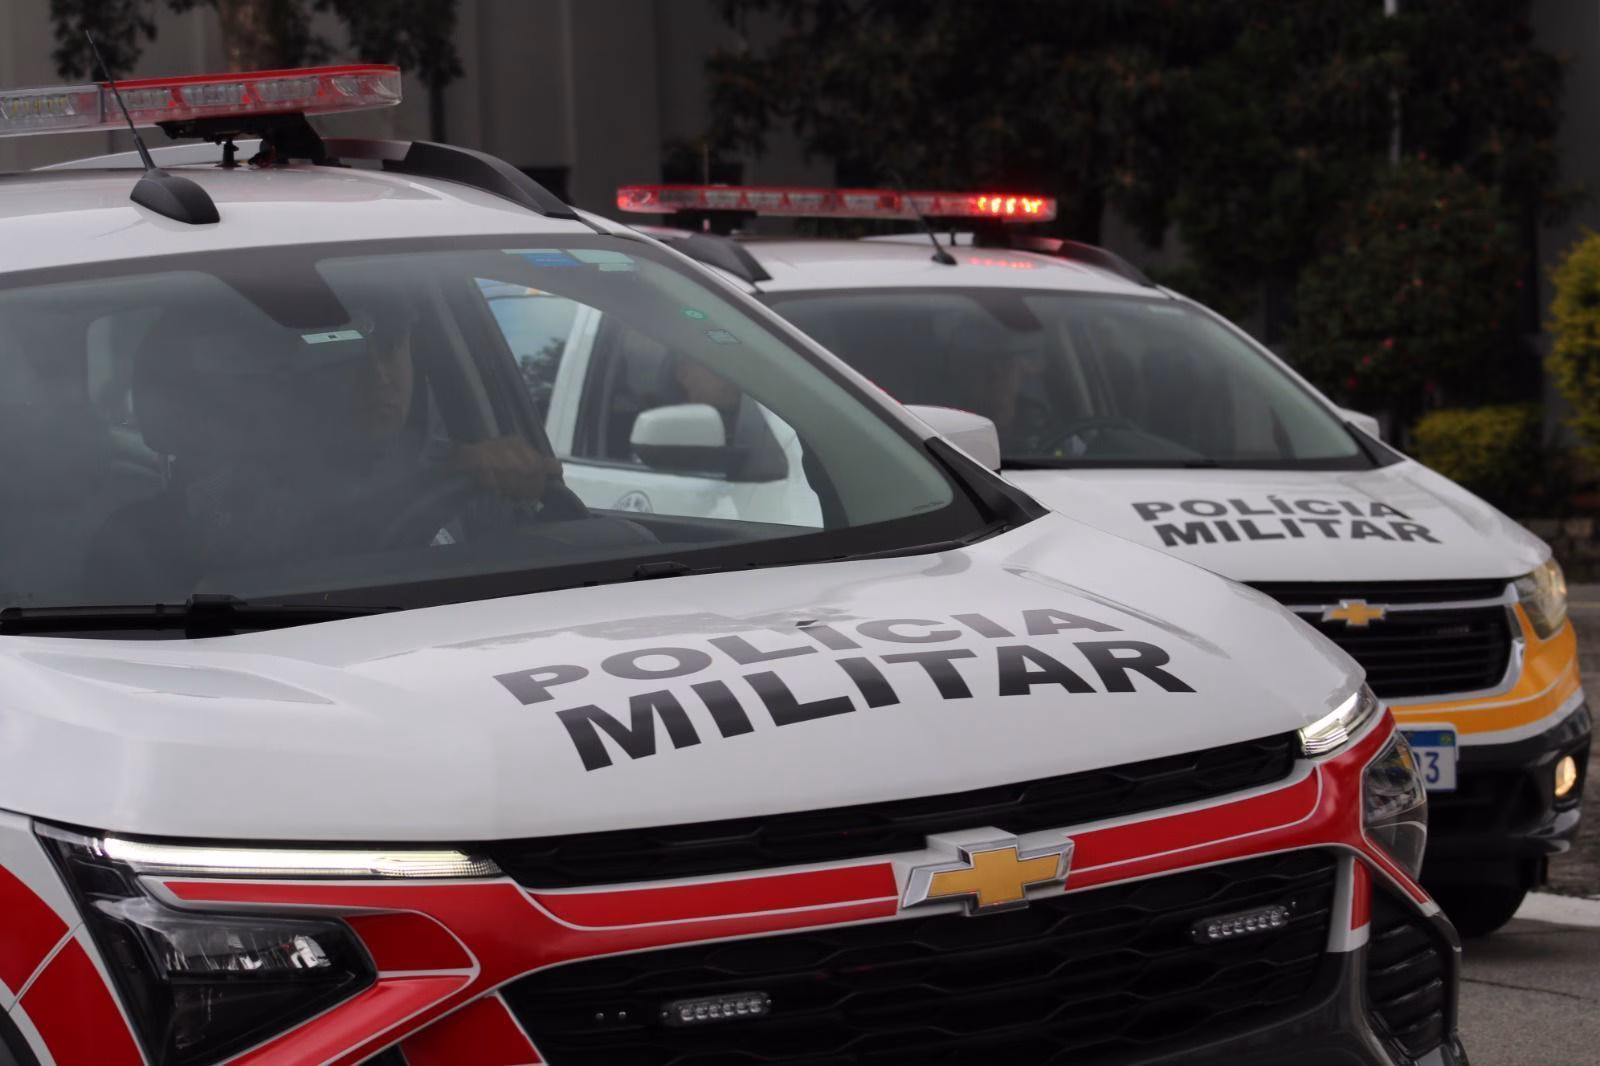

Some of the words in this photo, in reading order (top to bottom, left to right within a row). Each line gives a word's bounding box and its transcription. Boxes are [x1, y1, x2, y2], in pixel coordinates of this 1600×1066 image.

[1131, 495, 1412, 521] POLÍCIA
[1154, 518, 1443, 547] MILITAR
[493, 608, 1123, 705] POLÍCIA
[555, 640, 1198, 772] MILITAR
